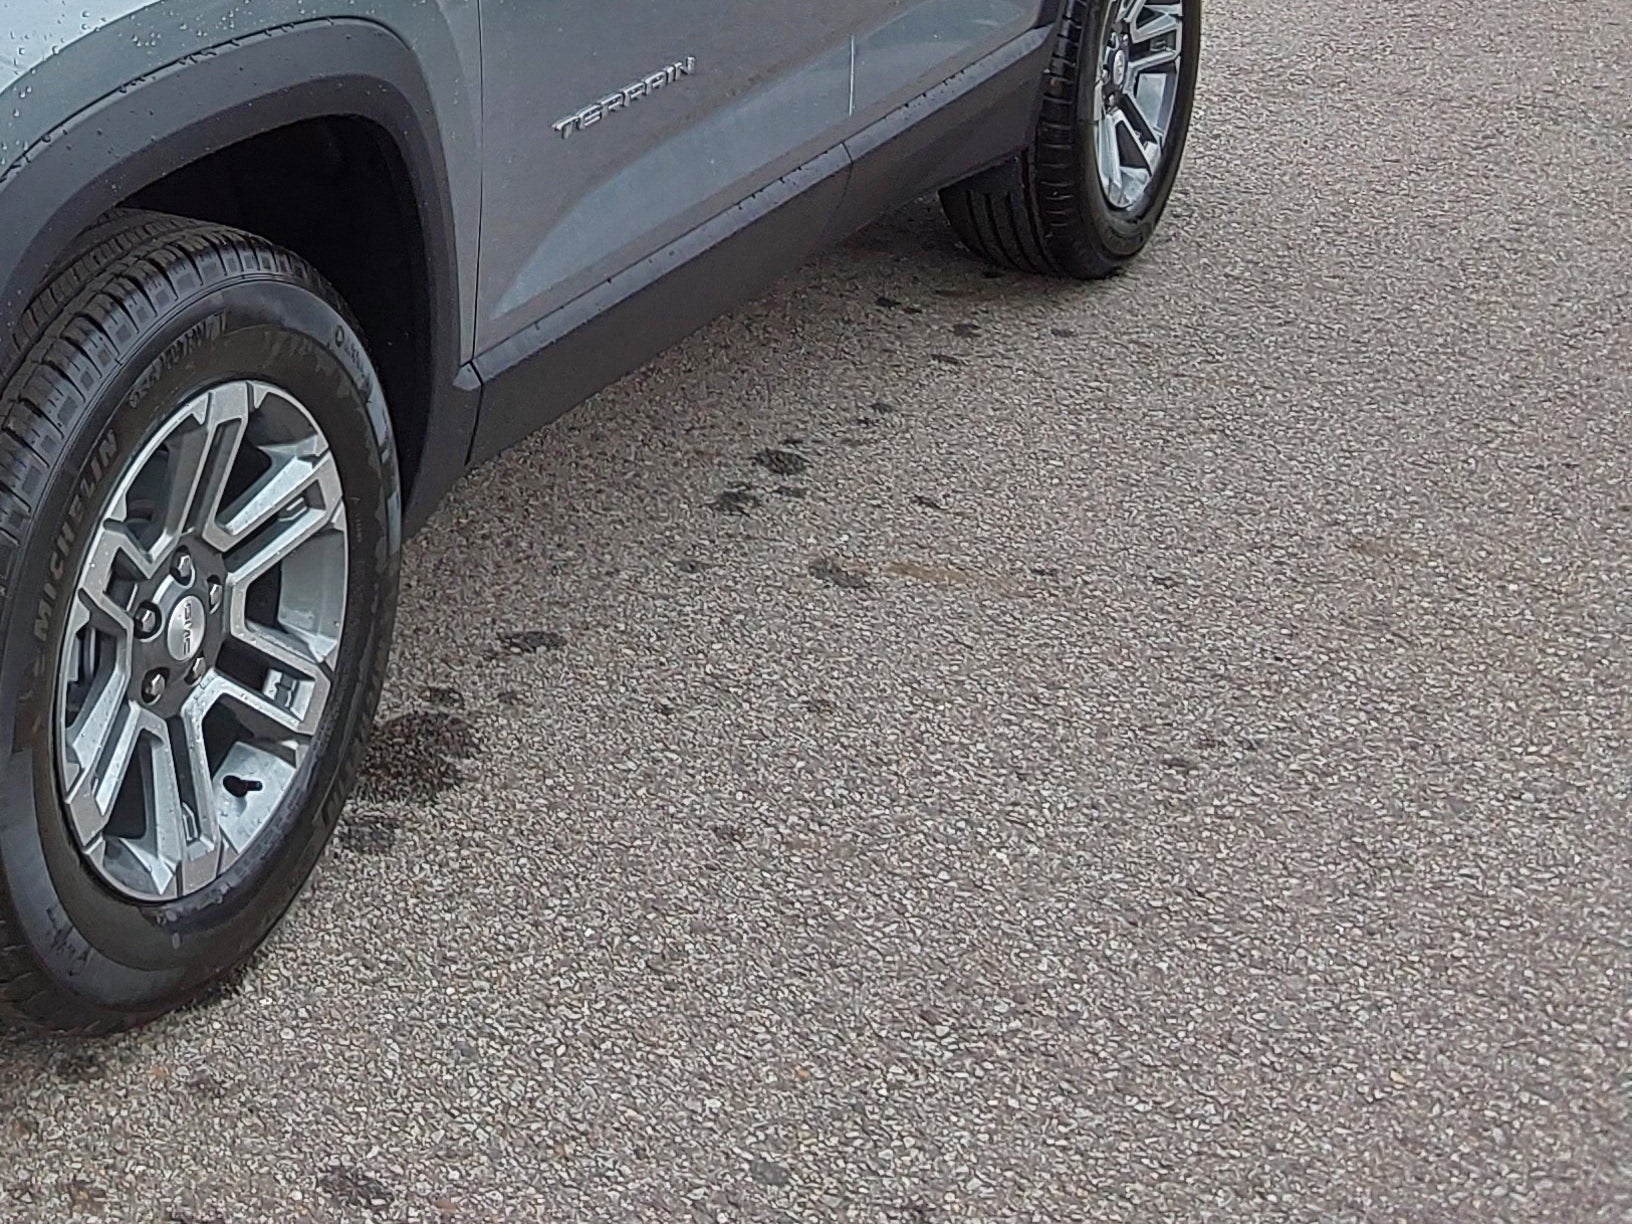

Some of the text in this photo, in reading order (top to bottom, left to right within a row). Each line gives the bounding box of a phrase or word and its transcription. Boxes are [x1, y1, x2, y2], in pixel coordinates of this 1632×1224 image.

[551, 55, 696, 140] TERRAIN
[32, 428, 120, 642] MICHELIN
[182, 600, 194, 657] GMC
